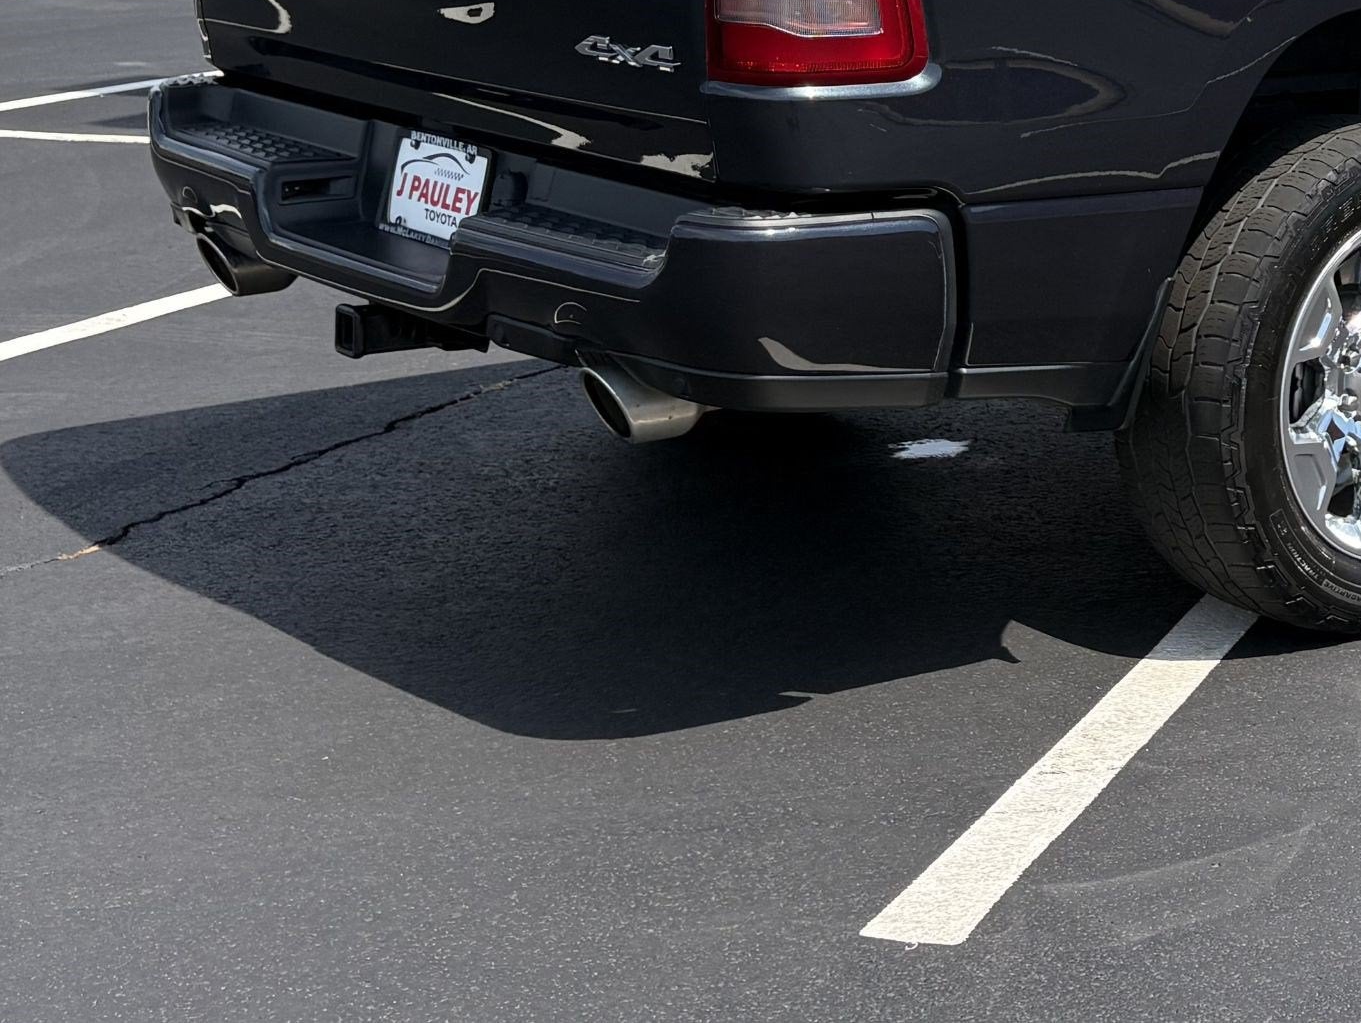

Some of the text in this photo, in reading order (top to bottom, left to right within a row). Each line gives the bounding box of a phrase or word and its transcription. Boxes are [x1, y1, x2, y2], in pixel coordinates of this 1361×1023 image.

[396, 172, 479, 216] J PAULEY
[424, 208, 458, 228] TOYOTA
